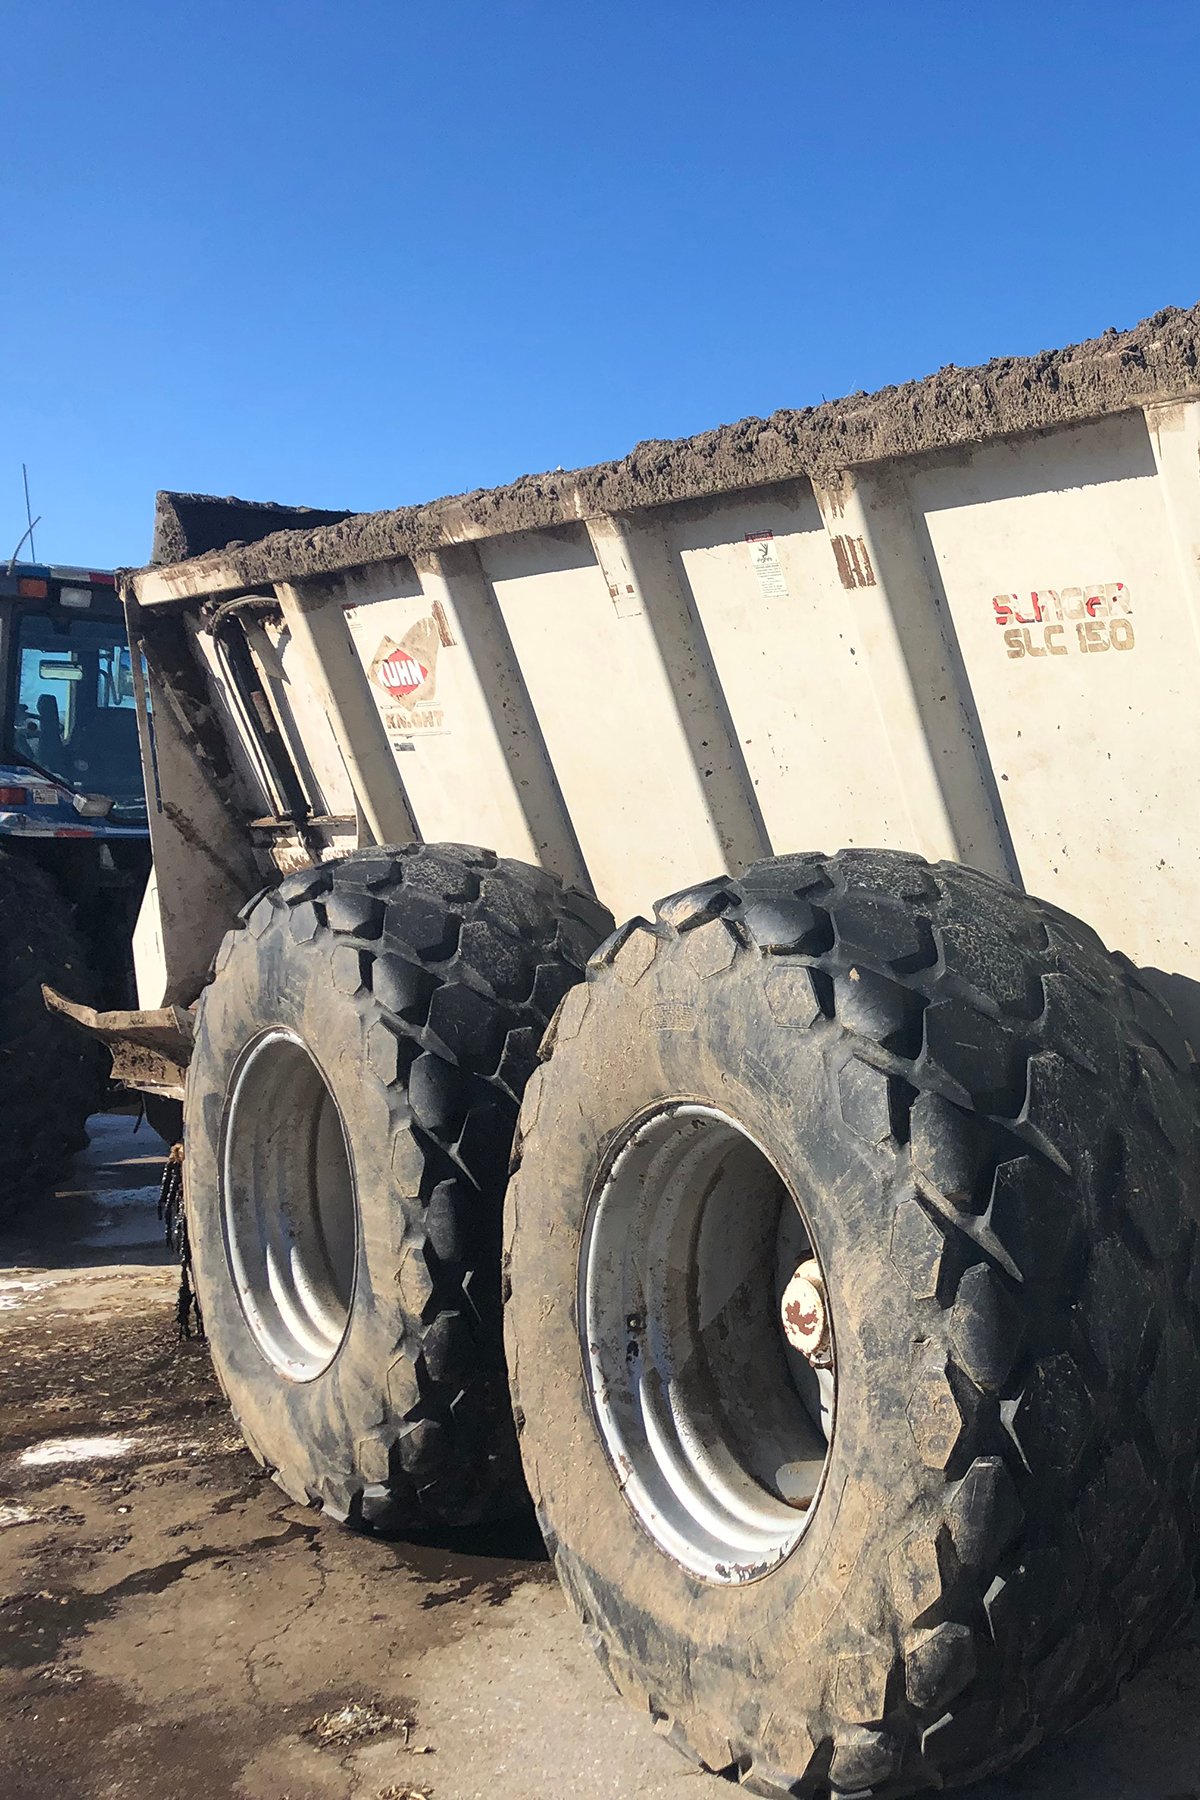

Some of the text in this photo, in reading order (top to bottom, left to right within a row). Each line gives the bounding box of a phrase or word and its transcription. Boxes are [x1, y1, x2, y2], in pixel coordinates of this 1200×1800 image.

[1004, 618, 1135, 659] SLC 150
[378, 659, 426, 689] KUHN
